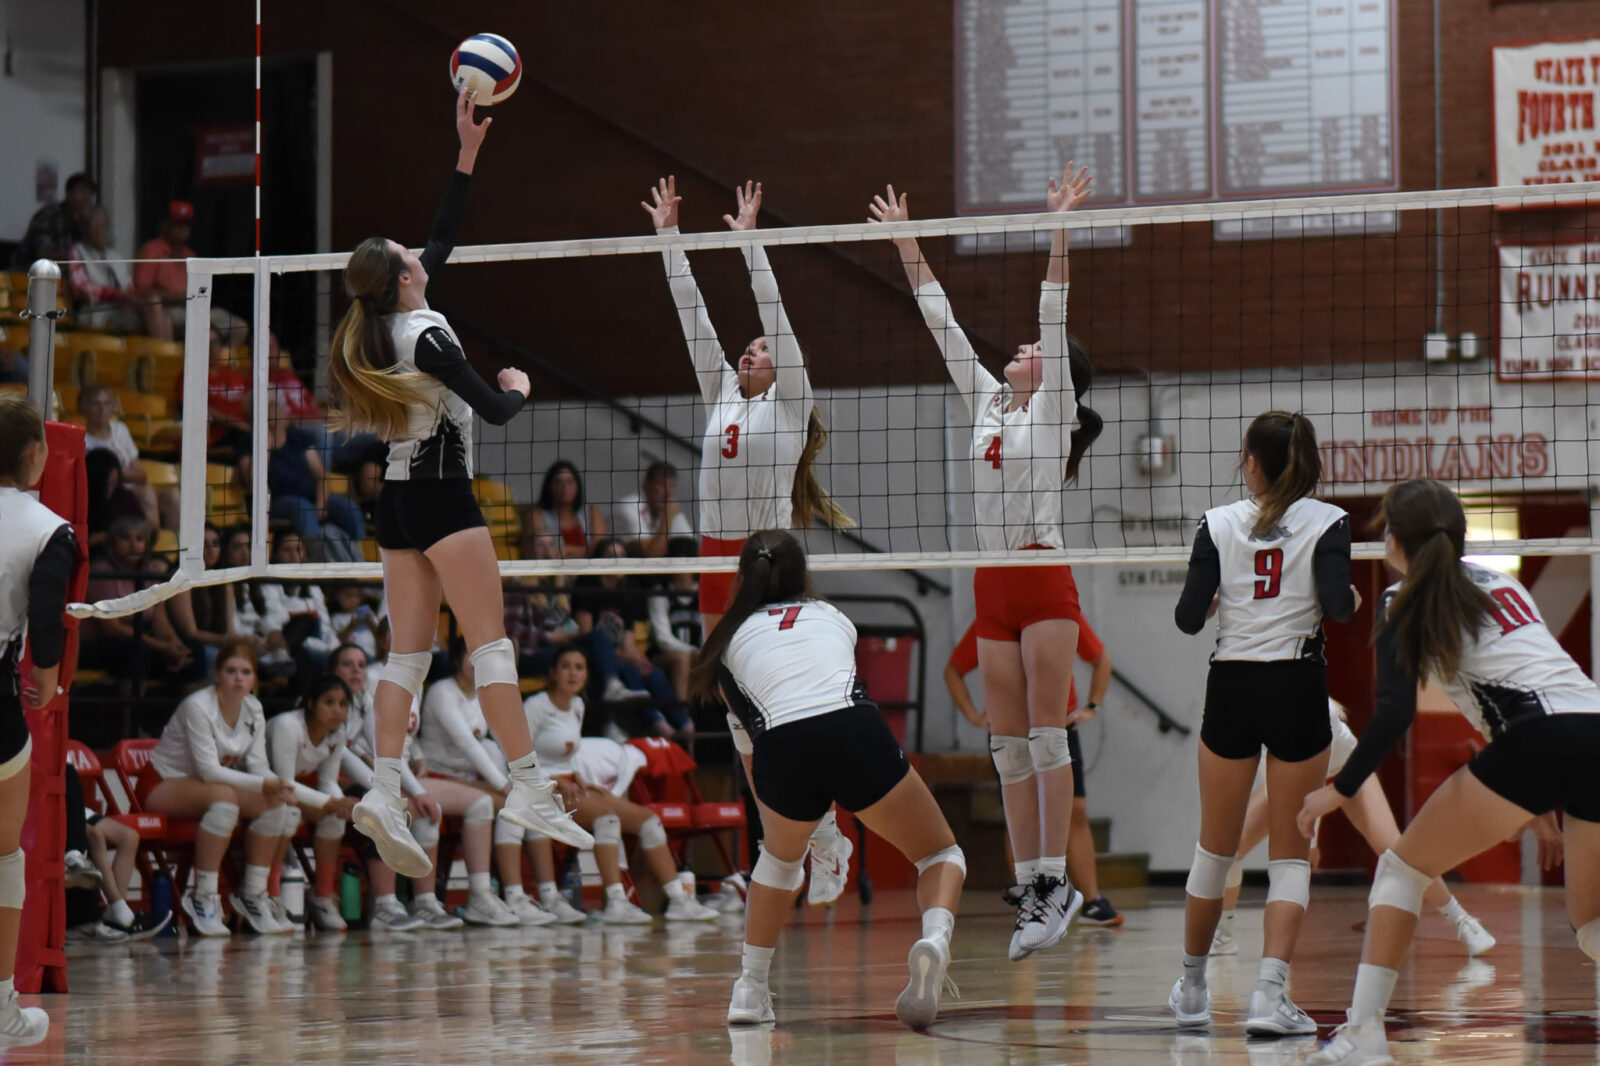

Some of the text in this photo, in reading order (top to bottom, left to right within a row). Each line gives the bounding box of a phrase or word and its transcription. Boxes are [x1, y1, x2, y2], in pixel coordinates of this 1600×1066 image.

[1517, 90, 1595, 145] FOURTH
[1371, 404, 1495, 427] HOME OF THE
[721, 424, 740, 460] 3
[984, 435, 1002, 470] 4
[1320, 432, 1549, 485] INDIANS
[1253, 548, 1284, 600] 9
[767, 605, 803, 632] 7
